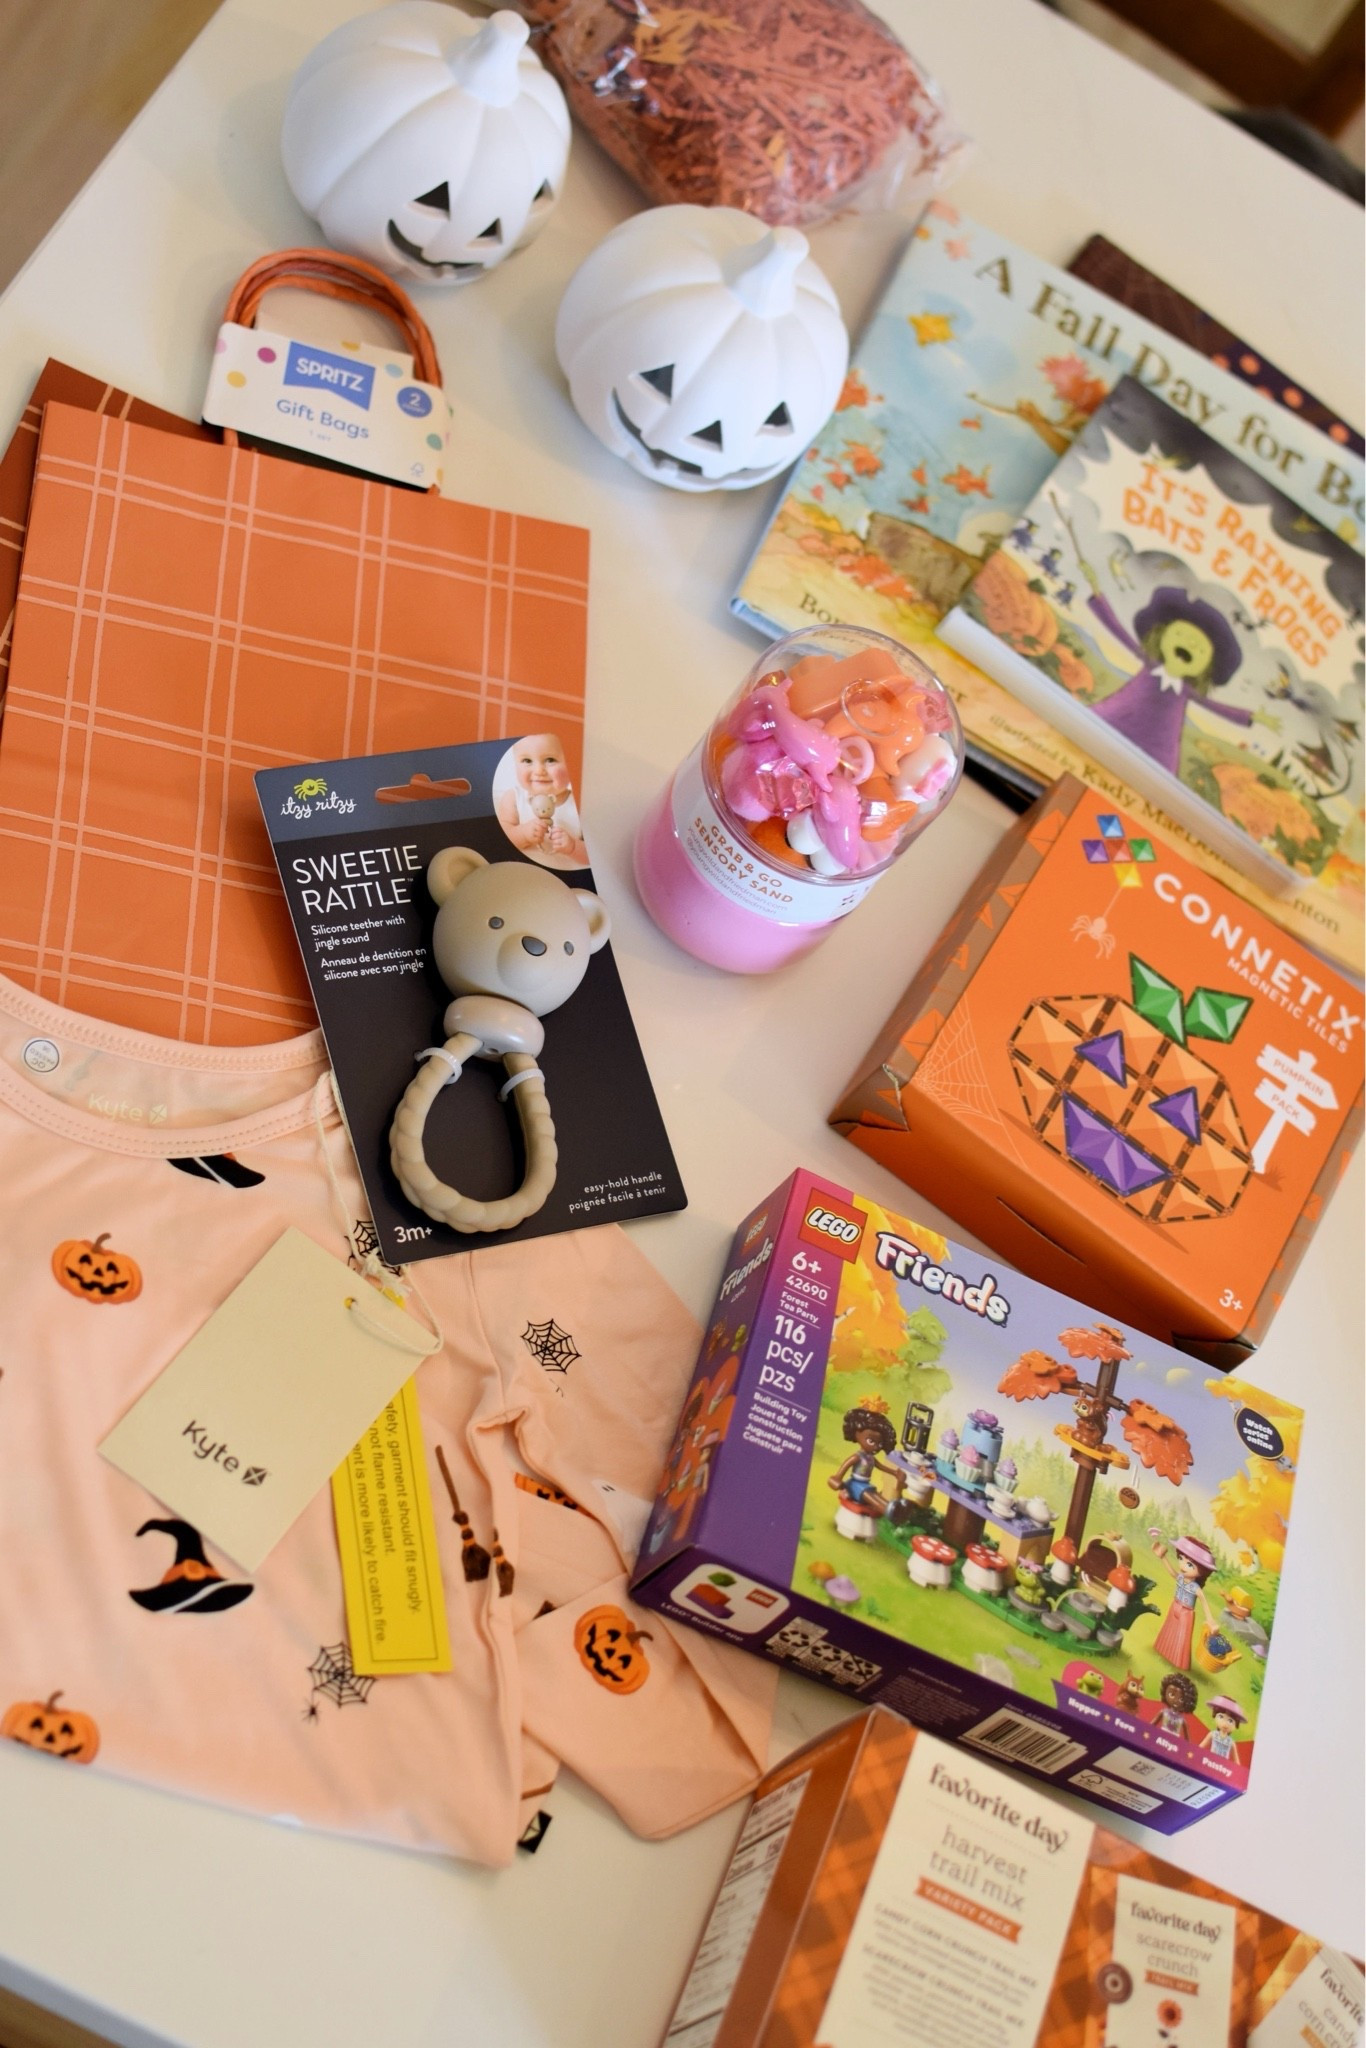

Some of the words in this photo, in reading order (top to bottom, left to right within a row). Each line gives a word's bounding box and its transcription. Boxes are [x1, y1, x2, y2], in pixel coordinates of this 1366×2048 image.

[296, 357, 365, 393] SPRITZ
[976, 256, 1013, 299] A
[1027, 280, 1122, 363] Fall
[1129, 342, 1227, 424] Day
[1233, 411, 1307, 475] for
[409, 393, 421, 407] 2
[276, 399, 314, 421] Gift
[320, 411, 369, 439] Bags
[1139, 461, 1208, 517] IT'S
[1216, 505, 1342, 639] RAINING
[1122, 487, 1205, 555] BATS
[1238, 565, 1328, 668] FROGS
[280, 796, 312, 820] itzy
[315, 791, 357, 815] ritzy
[292, 844, 423, 884] SWEETIE
[694, 817, 748, 880] SENSORY
[749, 880, 793, 903] SAND
[711, 825, 744, 863] GRAB
[744, 863, 755, 873] &
[758, 873, 783, 888] GO
[310, 923, 349, 936] Silicone
[349, 918, 384, 932] teether
[385, 914, 406, 926] with
[314, 936, 341, 952] jingle
[342, 932, 370, 945] sound
[1153, 872, 1361, 1041] CONNETIX
[320, 955, 357, 969] Anneau
[359, 953, 371, 964] de
[372, 948, 413, 962] dentition
[415, 947, 427, 956] en
[323, 966, 358, 981] silicone
[360, 965, 382, 976] avec
[383, 963, 399, 973] son
[399, 959, 425, 975] jingle
[1227, 957, 1302, 1019] MAGNETIC
[1306, 1014, 1349, 1054] TILES
[1273, 1057, 1325, 1098] PUMPKIN
[88, 1093, 144, 1121] Kyte
[1271, 1093, 1301, 1120] PACK
[584, 1175, 629, 1195] easy-hold
[631, 1171, 662, 1184] handle
[568, 1196, 606, 1213] poignée
[608, 1190, 634, 1203] facile
[636, 1188, 642, 1198] à
[643, 1185, 666, 1196] tenir
[394, 1225, 433, 1243] 3m+
[806, 1208, 860, 1242] LEGO
[720, 1237, 773, 1301] Friends
[792, 1251, 822, 1274] 6+
[786, 1275, 828, 1301] 42690
[876, 1232, 1011, 1326] Friends
[780, 1299, 795, 1312] Tea
[796, 1307, 819, 1323] Party
[781, 1291, 809, 1309] Forest
[1218, 1288, 1244, 1312] 3+
[774, 1314, 807, 1345] 116
[766, 1339, 814, 1374] pcs/
[759, 1364, 796, 1393] pzs
[750, 1403, 776, 1420] Jouet
[776, 1415, 789, 1425] de
[753, 1391, 790, 1416] Building
[791, 1408, 808, 1423] Toy
[370, 1427, 382, 1449] not
[745, 1423, 781, 1444] Juguete
[782, 1439, 802, 1453] para
[748, 1412, 803, 1441] construction
[1243, 1427, 1270, 1441] series
[1244, 1417, 1274, 1436] Watch
[182, 1420, 240, 1473] Kyte
[743, 1431, 784, 1454] Construir
[1246, 1435, 1274, 1452] online
[355, 1468, 367, 1479] is
[373, 1452, 386, 1490] flame
[387, 1440, 408, 1497] garment
[357, 1483, 370, 1518] more
[378, 1493, 396, 1556] resistant.
[398, 1500, 415, 1546] should
[362, 1521, 377, 1556] likely
[367, 1560, 378, 1574] to
[405, 1550, 417, 1562] fit
[369, 1577, 384, 1616] catch
[406, 1565, 423, 1614] snugly.
[375, 1619, 387, 1645] fire.
[691, 1615, 725, 1633] Builder
[725, 1631, 744, 1642] app
[1068, 1697, 1101, 1717] Hopper
[1114, 1717, 1136, 1734] Fern
[1202, 1756, 1233, 1777] Paisley
[928, 1762, 1021, 1827] favorite
[1024, 1817, 1069, 1854] day
[941, 1824, 1029, 1884] harvest
[929, 1850, 979, 1889] trail
[980, 1877, 1026, 1912] mix
[924, 1882, 977, 1916] VARIETY
[978, 1909, 1013, 1935] PACK
[1129, 1901, 1191, 1933] favorite
[1192, 1919, 1222, 1945] day
[1136, 1931, 1213, 1964] scarecrow
[1147, 1952, 1200, 1978] crunch
[1319, 1967, 1364, 2028] favorite
[1298, 1999, 1326, 2037] corn
